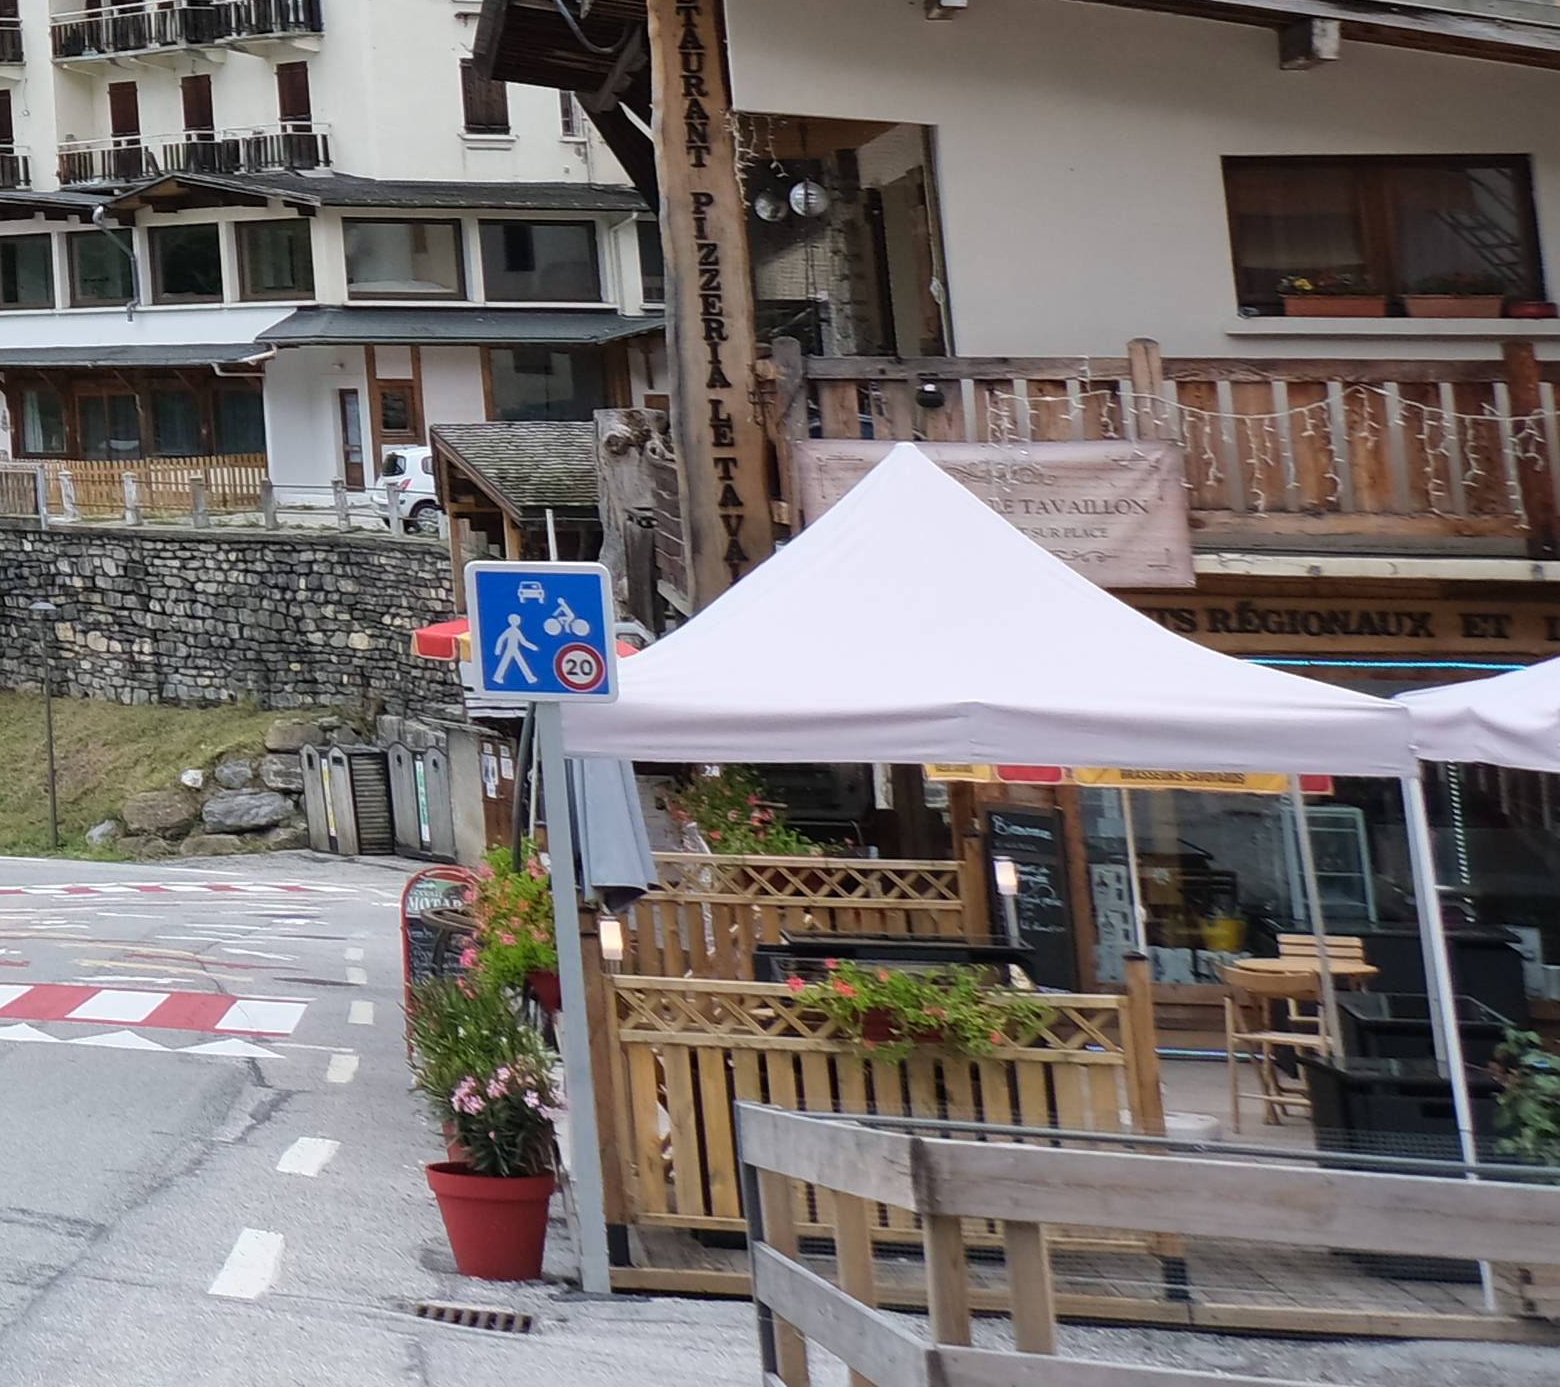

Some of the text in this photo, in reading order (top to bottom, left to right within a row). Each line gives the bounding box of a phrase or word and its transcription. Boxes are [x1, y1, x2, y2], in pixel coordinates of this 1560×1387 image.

[690, 191, 732, 389] PIZZERIA
[708, 398, 735, 447] LE
[1018, 497, 1150, 516] TAVAILLON
[1031, 526, 1062, 539] SUR
[1064, 526, 1110, 539] PLACE
[1207, 600, 1436, 639] RÉGIONAUX
[1458, 611, 1512, 640] ET
[565, 658, 593, 677] 20
